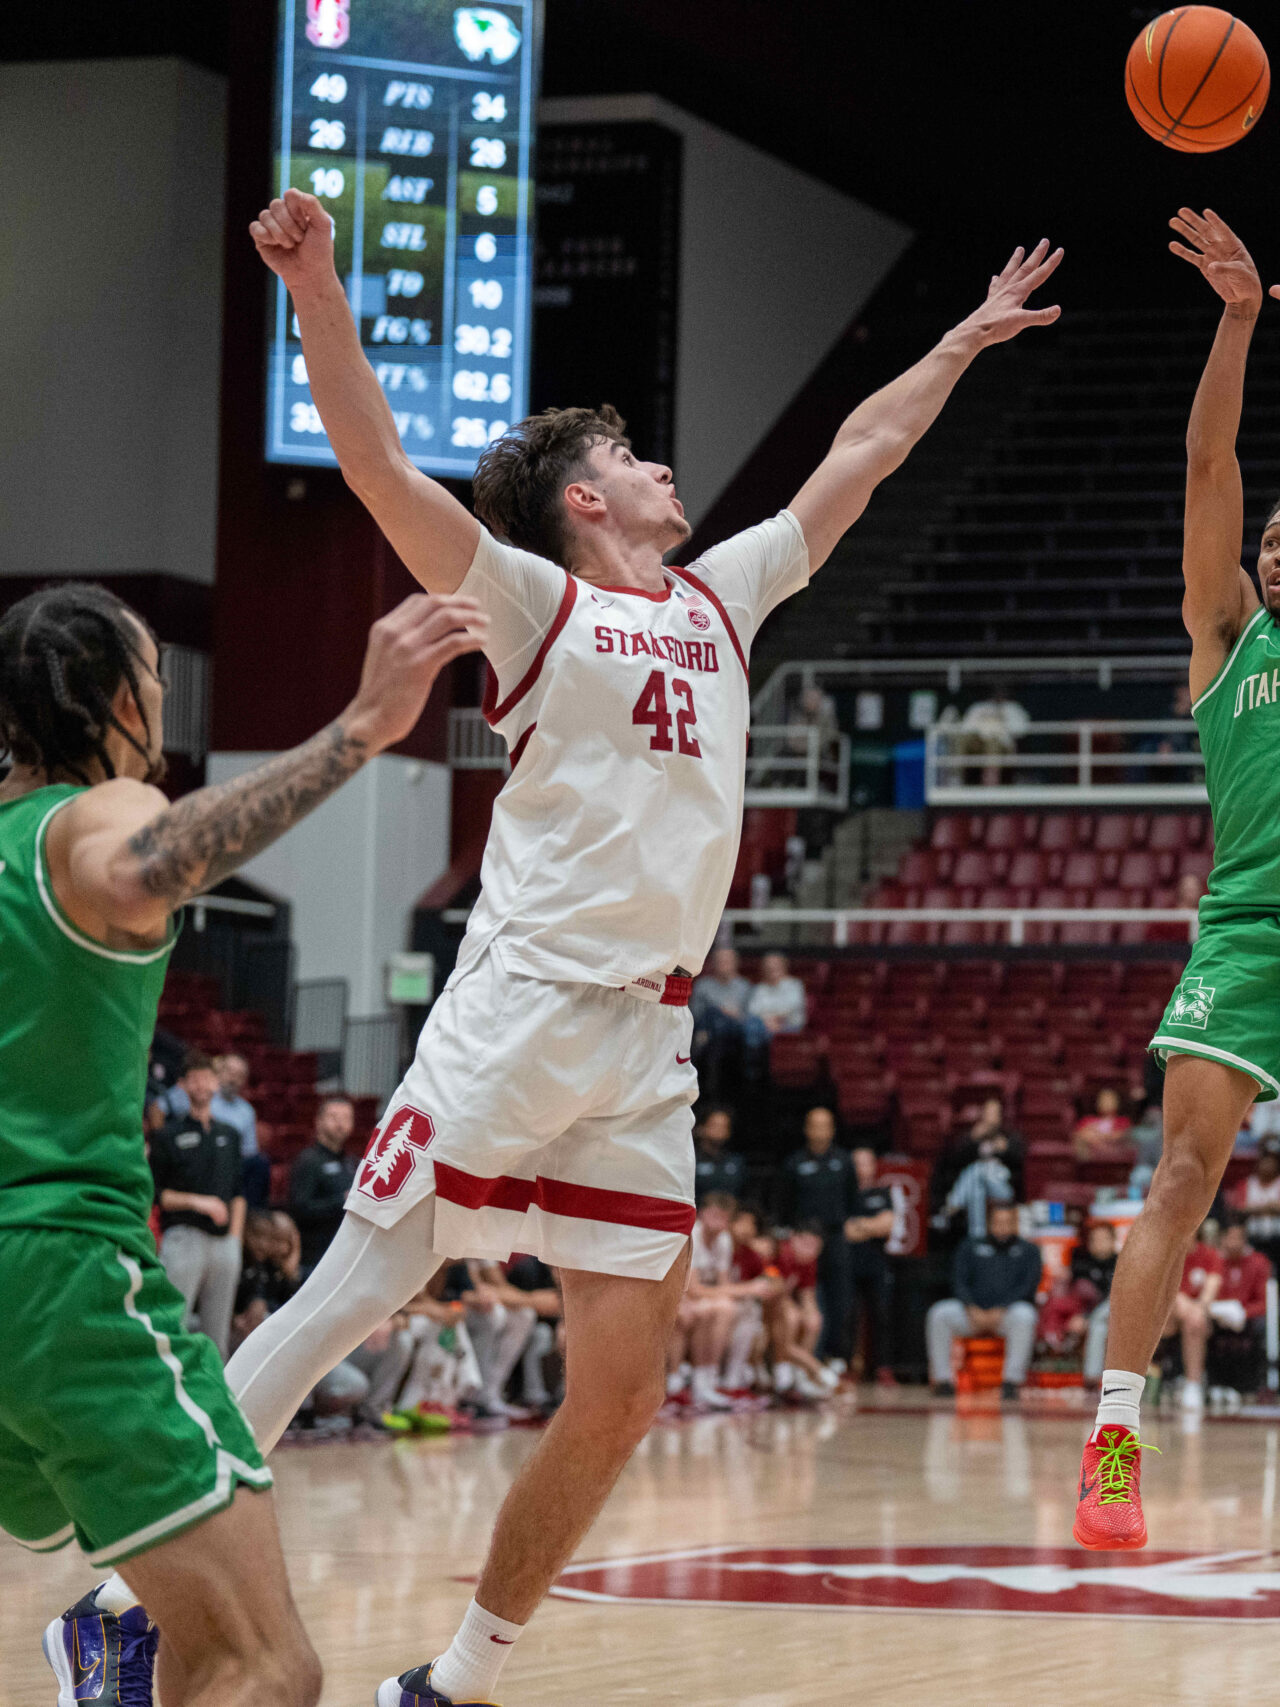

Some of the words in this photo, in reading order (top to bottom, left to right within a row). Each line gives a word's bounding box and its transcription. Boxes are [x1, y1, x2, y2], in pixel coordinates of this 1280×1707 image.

[310, 73, 347, 103] 49
[383, 80, 434, 110] PTS
[472, 91, 507, 122] 34
[309, 118, 346, 150] 26
[380, 126, 434, 157] REB
[470, 137, 507, 169] 28
[310, 167, 344, 198] 10
[382, 175, 434, 204] AST
[380, 222, 427, 251] STL
[387, 268, 424, 298] TO
[469, 279, 503, 310] 10
[632, 669, 702, 759] 42
